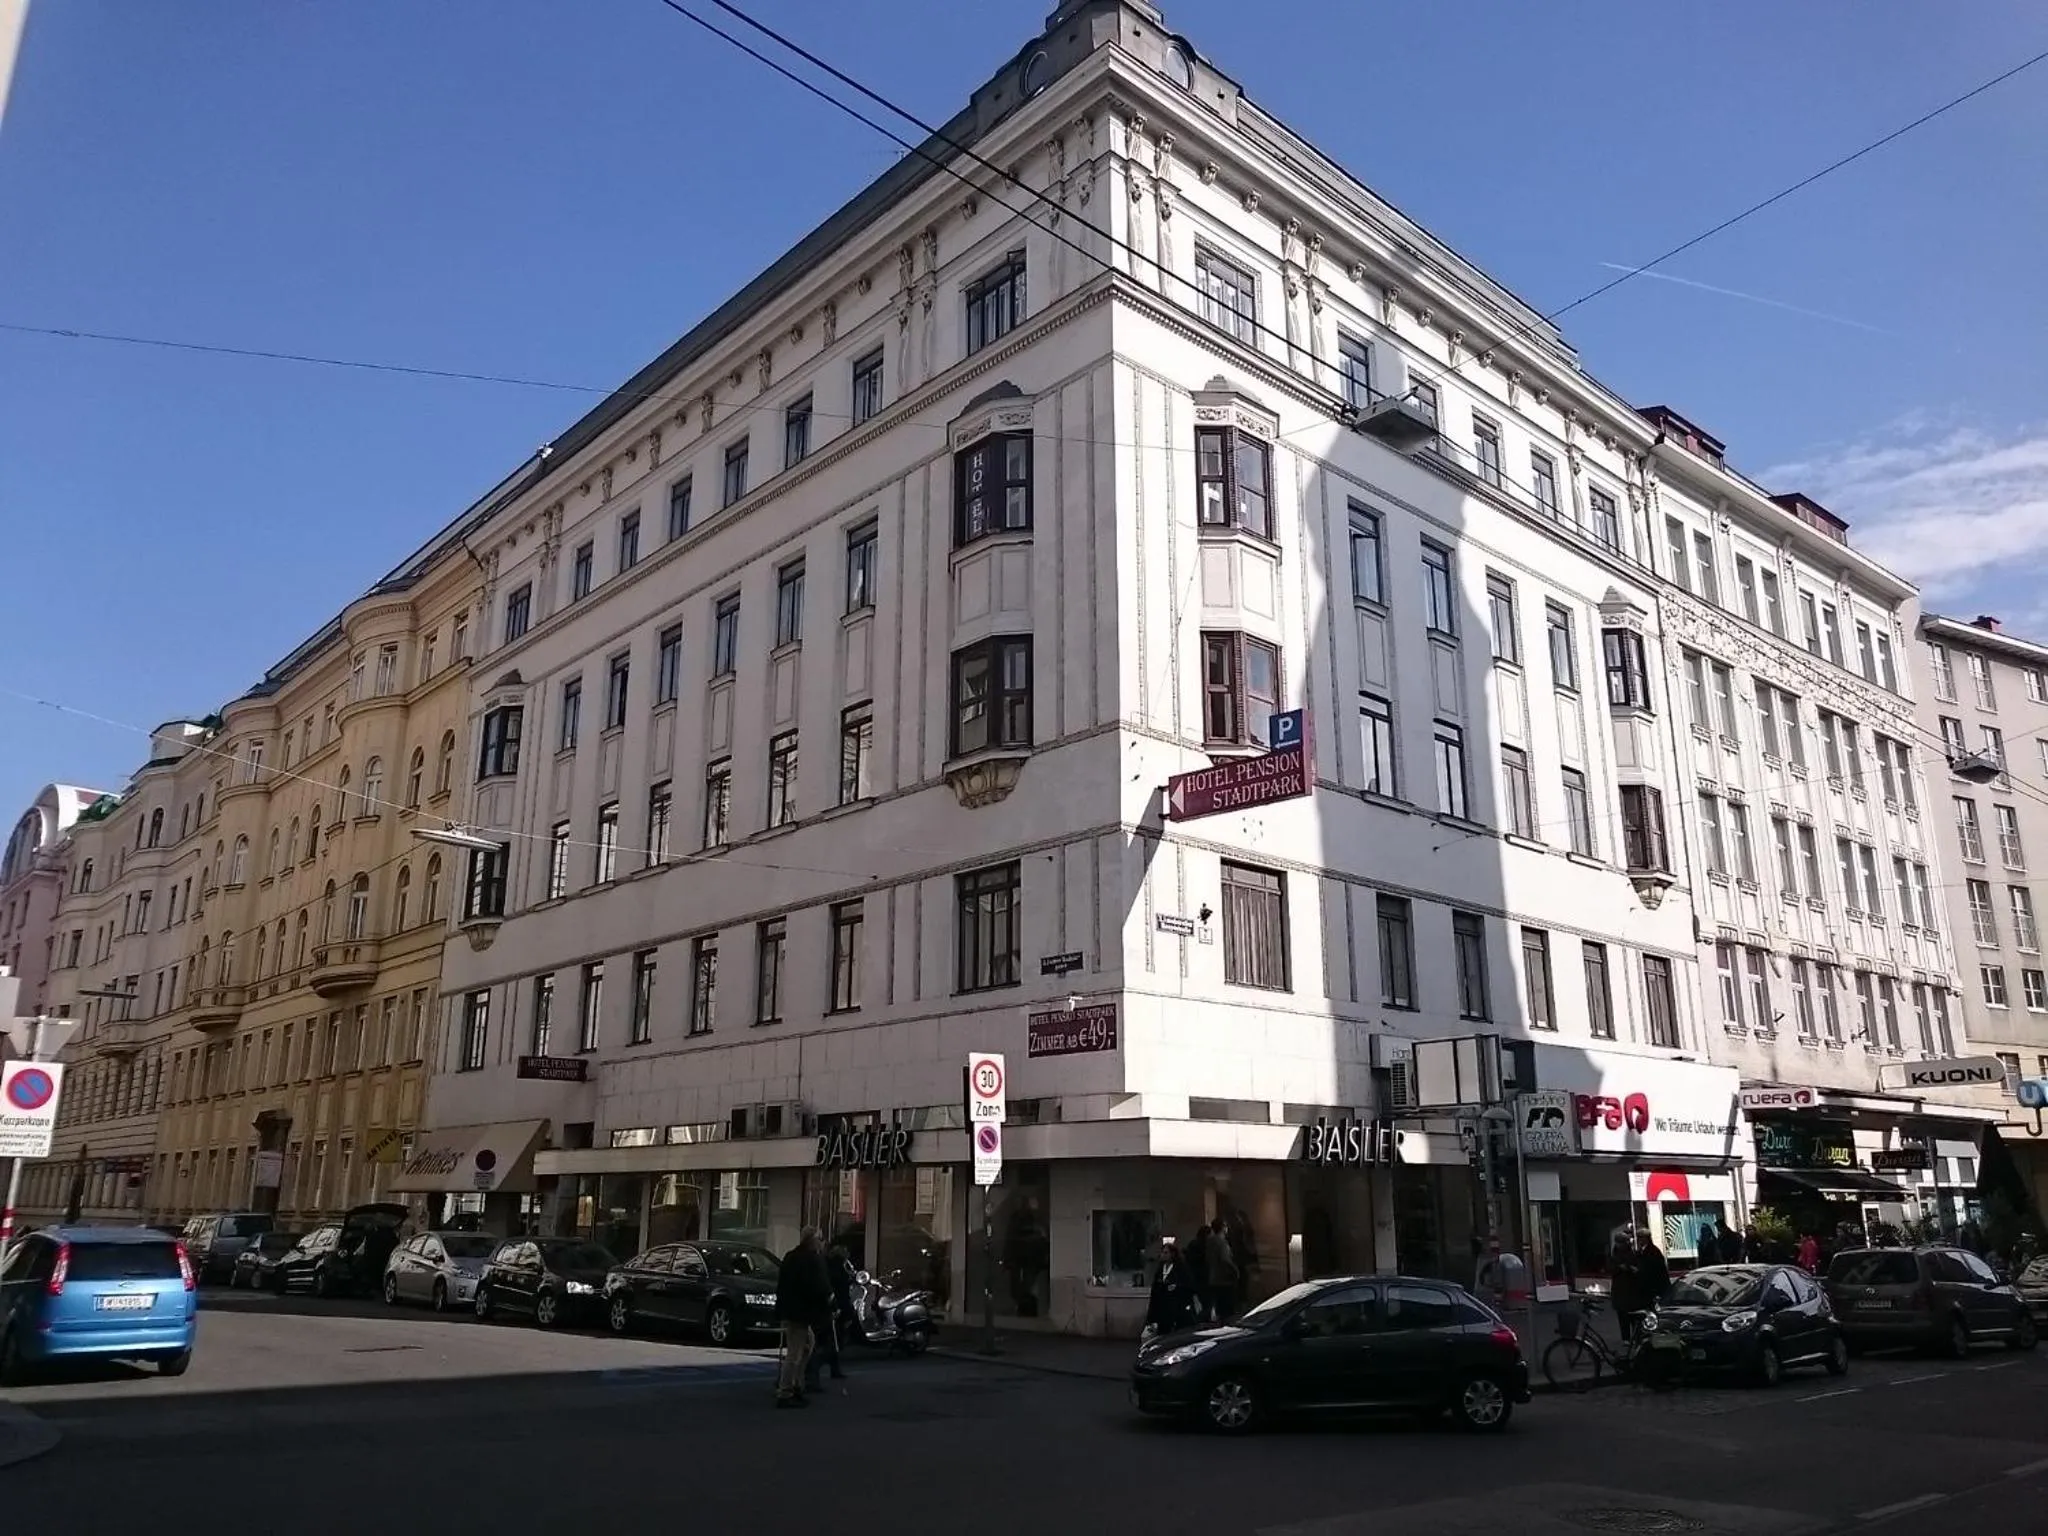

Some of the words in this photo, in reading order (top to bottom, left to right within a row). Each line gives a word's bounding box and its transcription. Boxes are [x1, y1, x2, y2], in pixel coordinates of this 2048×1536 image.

[972, 452, 983, 534] HOTEL
[1278, 717, 1293, 740] P
[1187, 767, 1233, 793] HOTEL
[1237, 751, 1300, 781] PENSION
[1213, 774, 1300, 809] STADTPARK
[981, 1070, 995, 1088] 30
[1912, 1067, 1992, 1085] KUONI
[976, 1101, 1001, 1117] Zone
[1576, 1094, 1622, 1130] efa
[1743, 1092, 1792, 1105] ruefa
[816, 1131, 908, 1166] BASLER
[1309, 1125, 1406, 1163] BASLER
